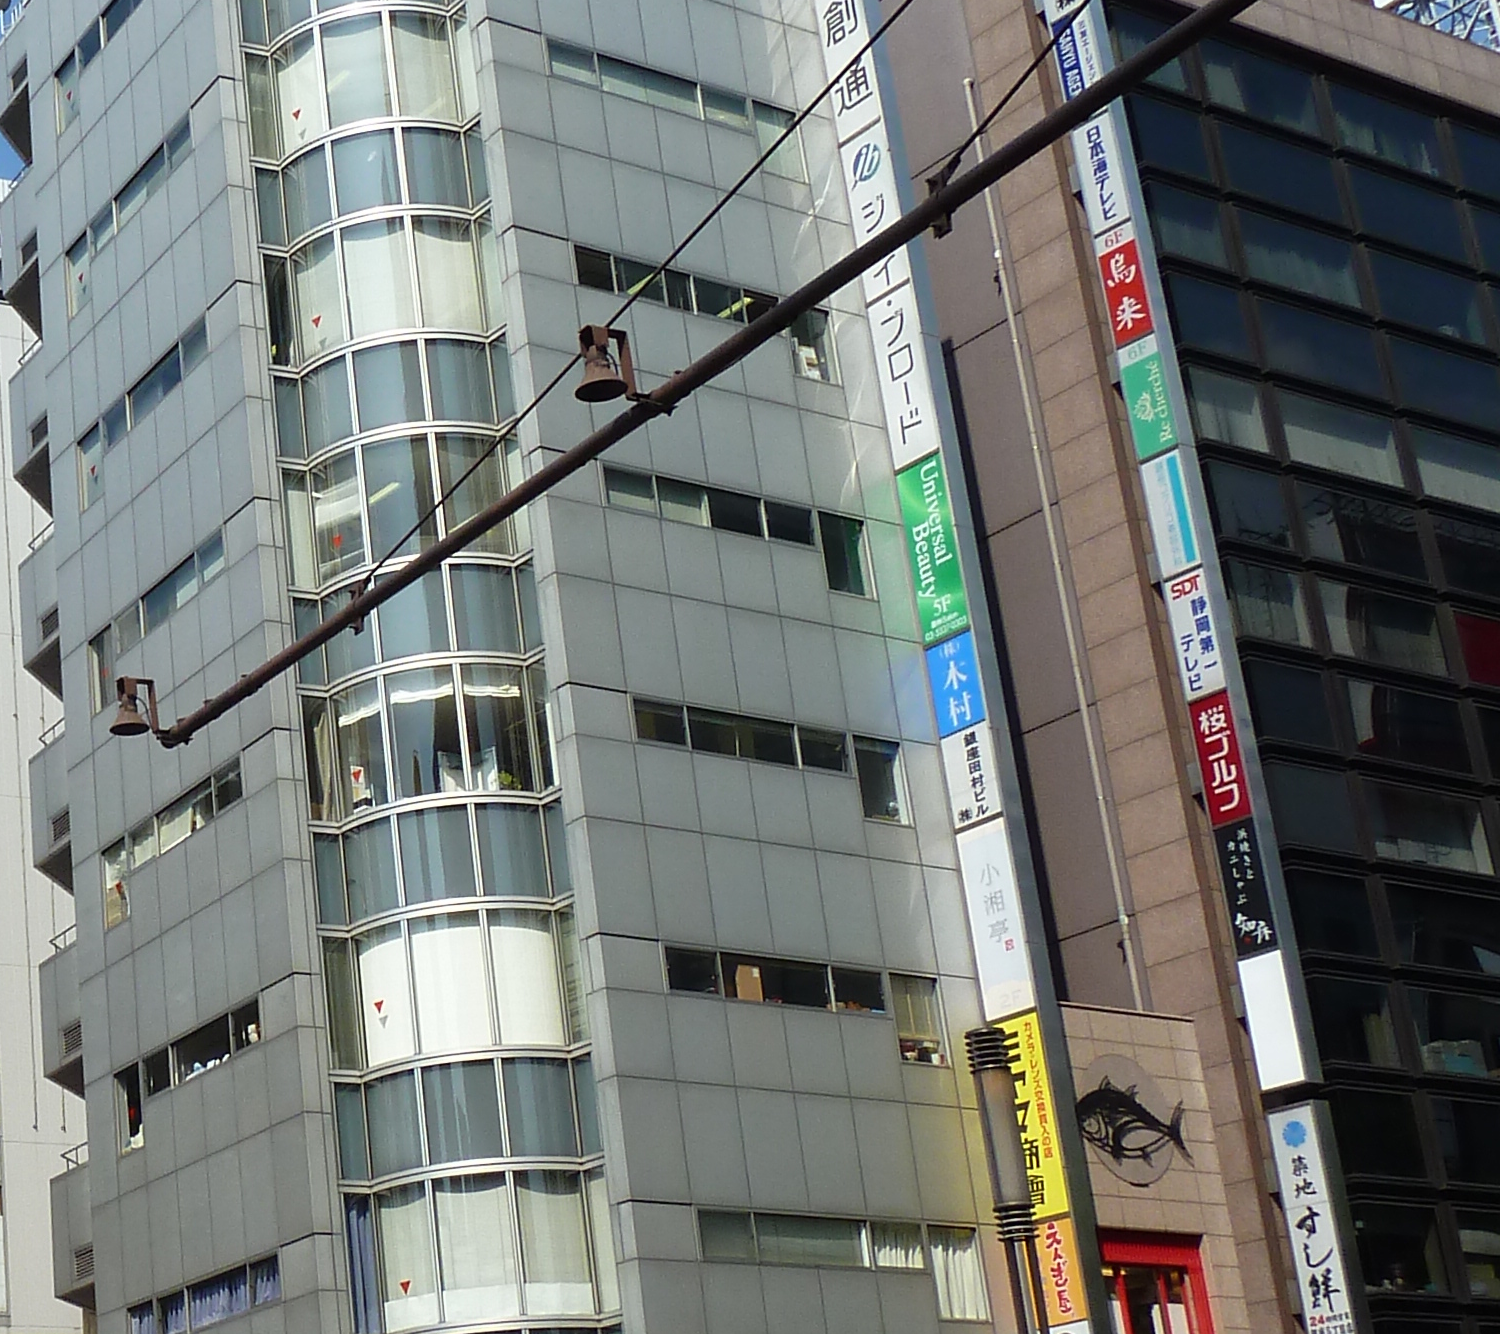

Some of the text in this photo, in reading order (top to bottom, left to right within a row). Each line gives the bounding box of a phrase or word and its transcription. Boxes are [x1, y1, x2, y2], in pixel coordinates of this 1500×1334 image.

[1086, 125, 1116, 221] 日本海テレビ
[1104, 229, 1125, 248] 6F
[1127, 342, 1148, 361] 6F
[920, 460, 953, 567] Universal
[912, 523, 938, 599] Beauty
[1170, 574, 1200, 601] SDT
[933, 593, 952, 617] 5F
[1190, 595, 1218, 669] 静岡第一
[943, 661, 972, 727] 木村
[1181, 633, 1204, 693] テレビ
[963, 730, 988, 818] 銀座田村ビル
[1199, 705, 1240, 813] 桜ゴルフ
[1291, 1154, 1316, 1197] 築地
[1296, 1205, 1340, 1313] すし鮮
